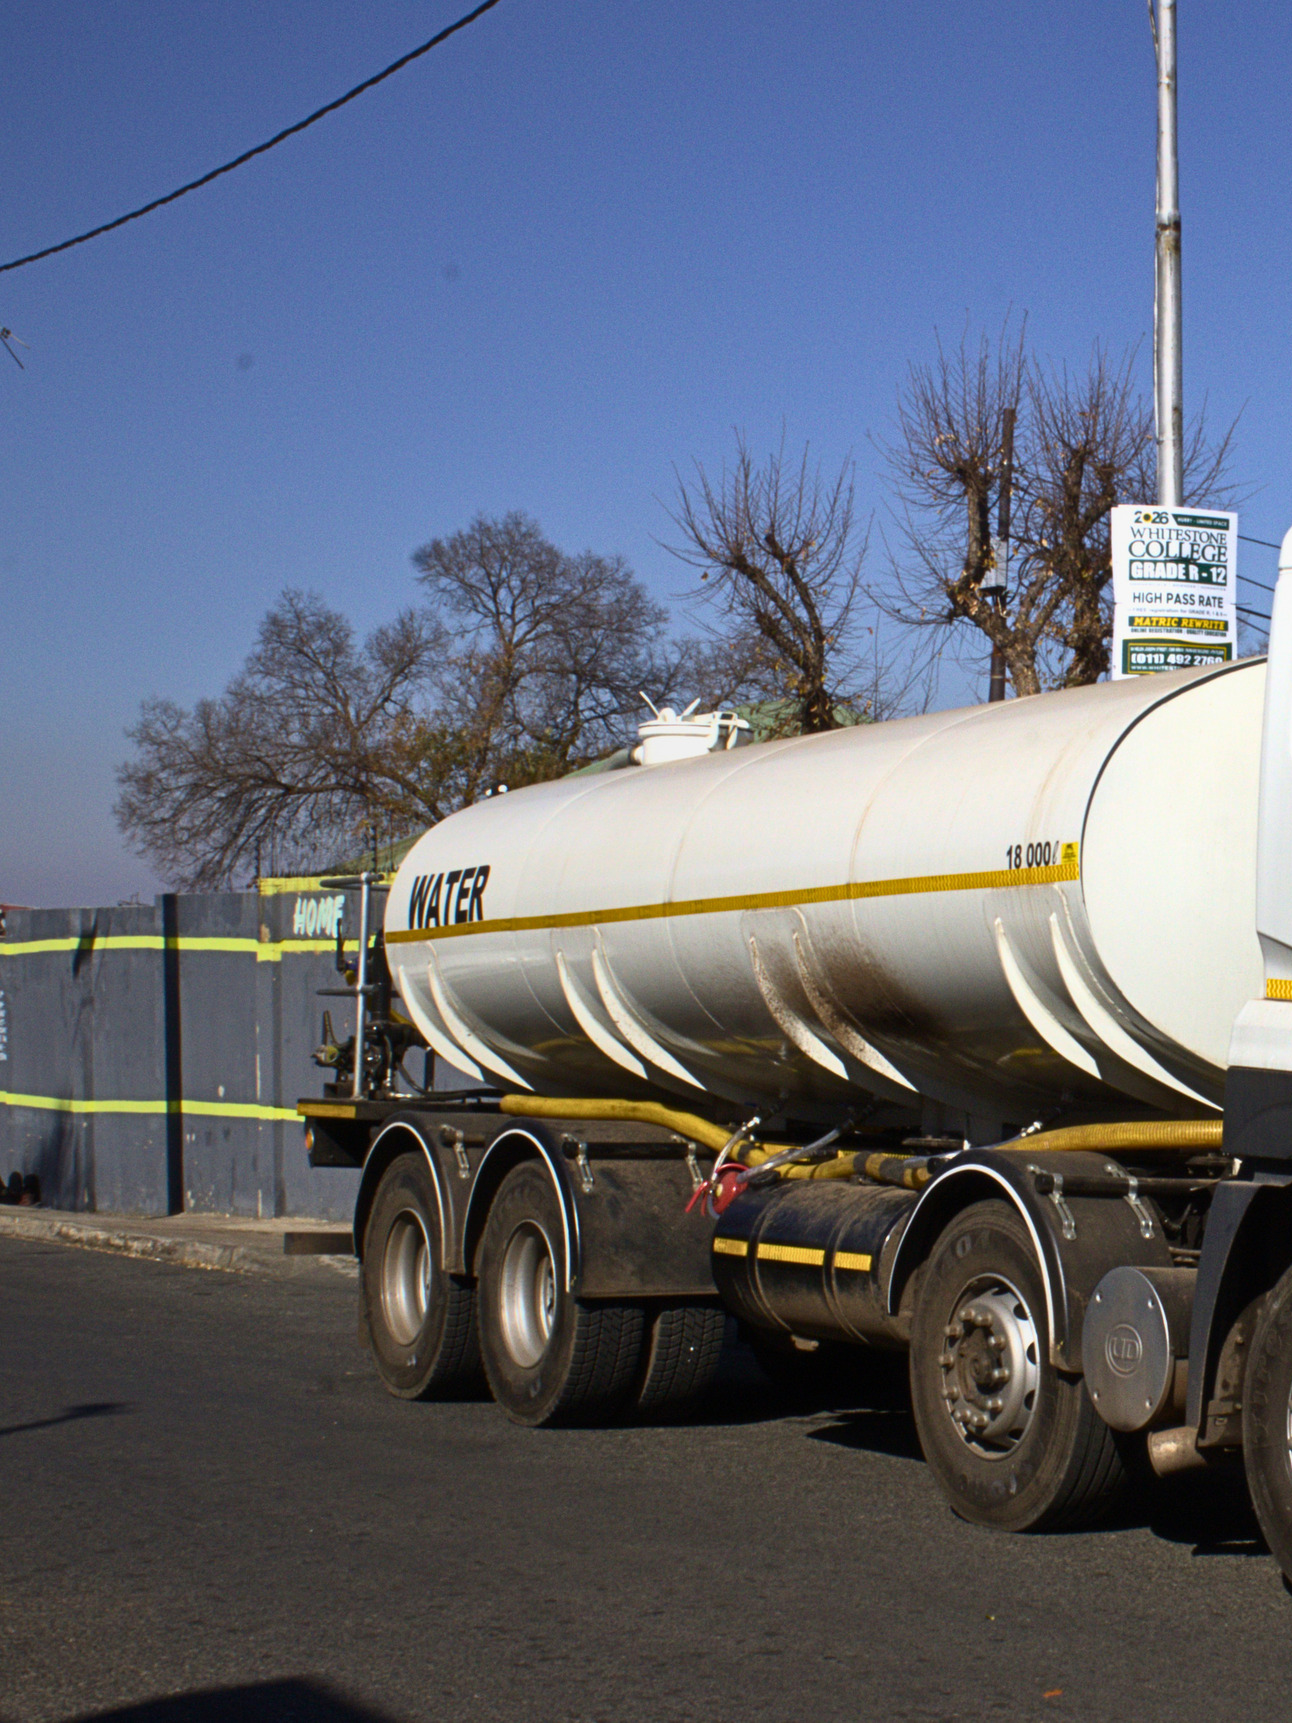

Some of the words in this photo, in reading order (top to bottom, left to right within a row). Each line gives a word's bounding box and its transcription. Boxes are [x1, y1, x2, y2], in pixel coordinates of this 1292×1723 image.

[1130, 526, 1227, 545] WHITESTONE
[1128, 540, 1228, 563] COLLEGE
[1130, 561, 1187, 580] GRADE
[1188, 564, 1199, 581] R
[1209, 566, 1226, 584] 12
[1133, 592, 1163, 603] HIGH
[1166, 593, 1196, 606] PASS
[1198, 594, 1224, 609] RATE
[1133, 616, 1179, 627] MATRIC
[1180, 618, 1225, 630] REWRITE
[1131, 652, 1165, 664] (011)
[1166, 653, 1192, 665] 492
[1006, 844, 1023, 869] 18
[408, 864, 491, 930] WATER
[294, 894, 346, 938] HOME
